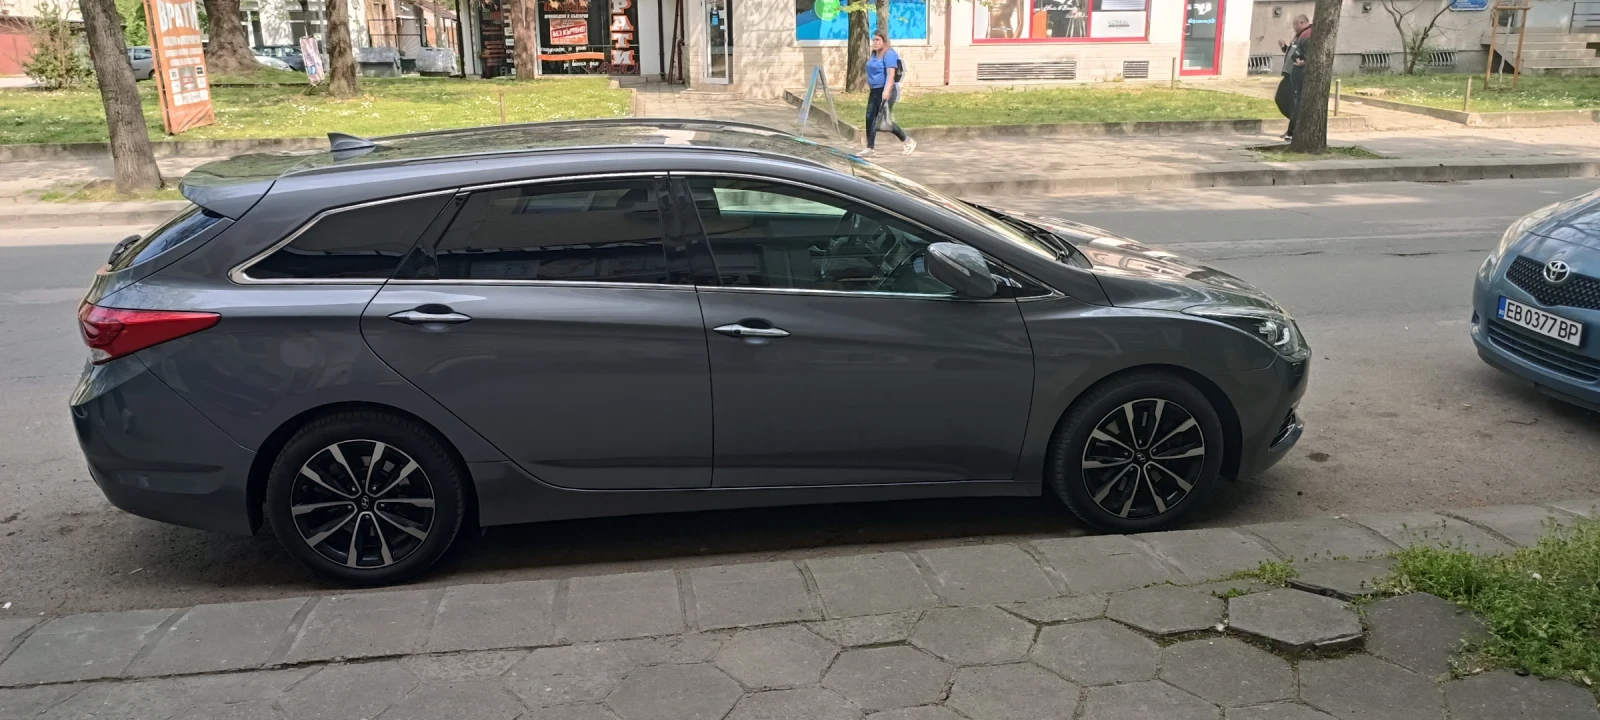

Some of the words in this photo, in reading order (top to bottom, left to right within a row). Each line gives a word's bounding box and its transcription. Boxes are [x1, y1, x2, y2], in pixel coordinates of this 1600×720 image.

[157, 0, 200, 33] ВРАТИ
[552, 30, 563, 38] БЕЗ
[1506, 301, 1523, 322] EB
[1524, 309, 1557, 334] 0377
[1558, 320, 1579, 341] BP
